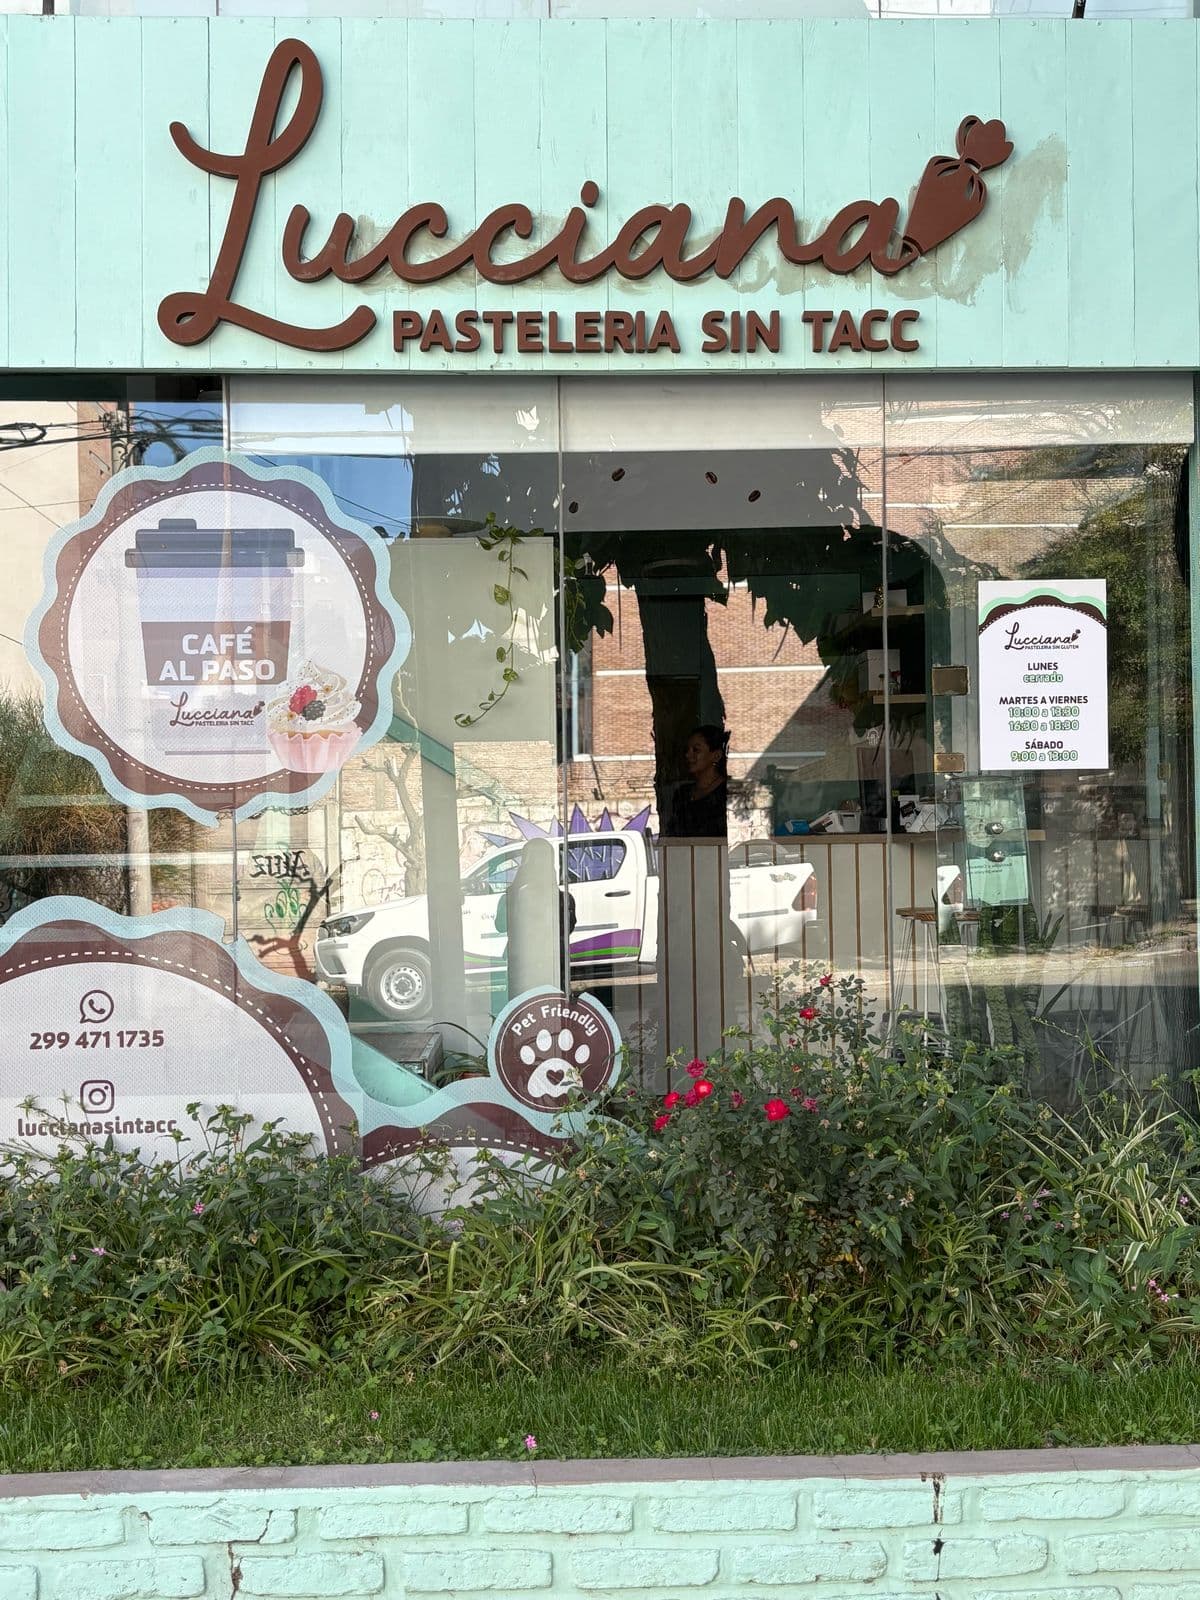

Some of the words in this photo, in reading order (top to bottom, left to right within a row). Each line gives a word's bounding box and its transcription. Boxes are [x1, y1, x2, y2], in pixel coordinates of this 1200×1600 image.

[157, 37, 912, 353] Lucciana
[392, 310, 679, 354] PASTELERIA
[701, 311, 780, 354] SIN
[802, 309, 920, 353] TACC
[182, 625, 253, 655] CAFÉ
[1004, 621, 1071, 651] Lucciana
[159, 660, 195, 681] AL
[202, 658, 275, 681] PASO
[1023, 671, 1064, 683] cerrado
[1027, 662, 1059, 671] LUNES
[169, 691, 255, 727] Lucciana
[999, 696, 1038, 705] MARTES
[1040, 696, 1047, 705] A
[1048, 695, 1088, 704] VIERNES
[1008, 706, 1040, 718] 10:00
[1041, 708, 1048, 717] a
[1008, 720, 1039, 731] 16:30
[1040, 722, 1047, 731] a
[1025, 738, 1064, 749] SÁBADO
[1010, 750, 1037, 762] 9:00
[1038, 752, 1046, 761] a
[511, 1012, 536, 1036] Pet
[540, 1004, 599, 1037] Friendly
[29, 1031, 70, 1050] 299
[75, 1030, 111, 1049] 471
[116, 1029, 165, 1048] 1735
[17, 1116, 178, 1137] luccianasintacc
